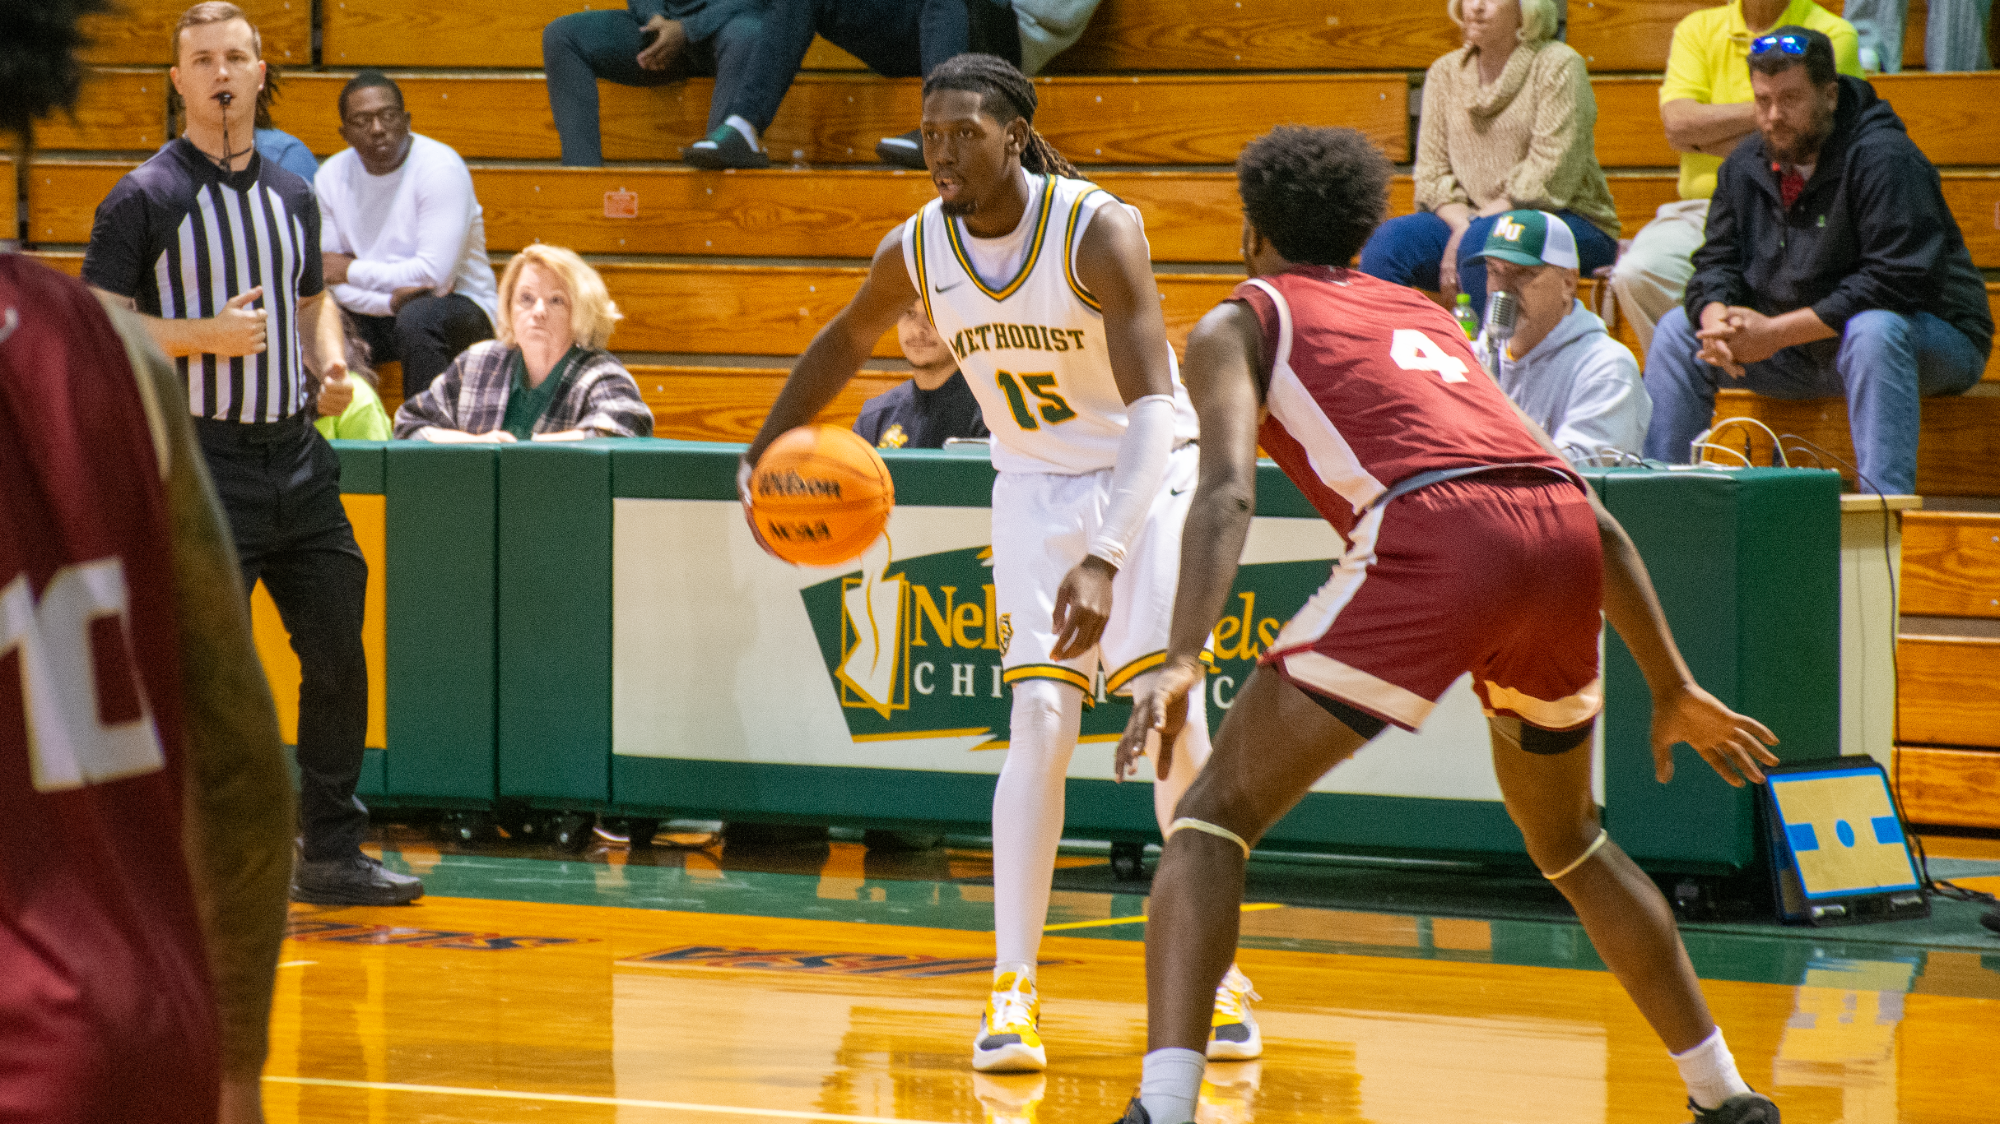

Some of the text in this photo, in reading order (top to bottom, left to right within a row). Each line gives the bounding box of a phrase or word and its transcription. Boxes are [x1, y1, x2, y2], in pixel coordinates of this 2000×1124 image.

[1493, 216, 1526, 242] MU
[949, 322, 1085, 362] METHODIST
[1389, 328, 1470, 384] 4
[994, 368, 1078, 431] 15
